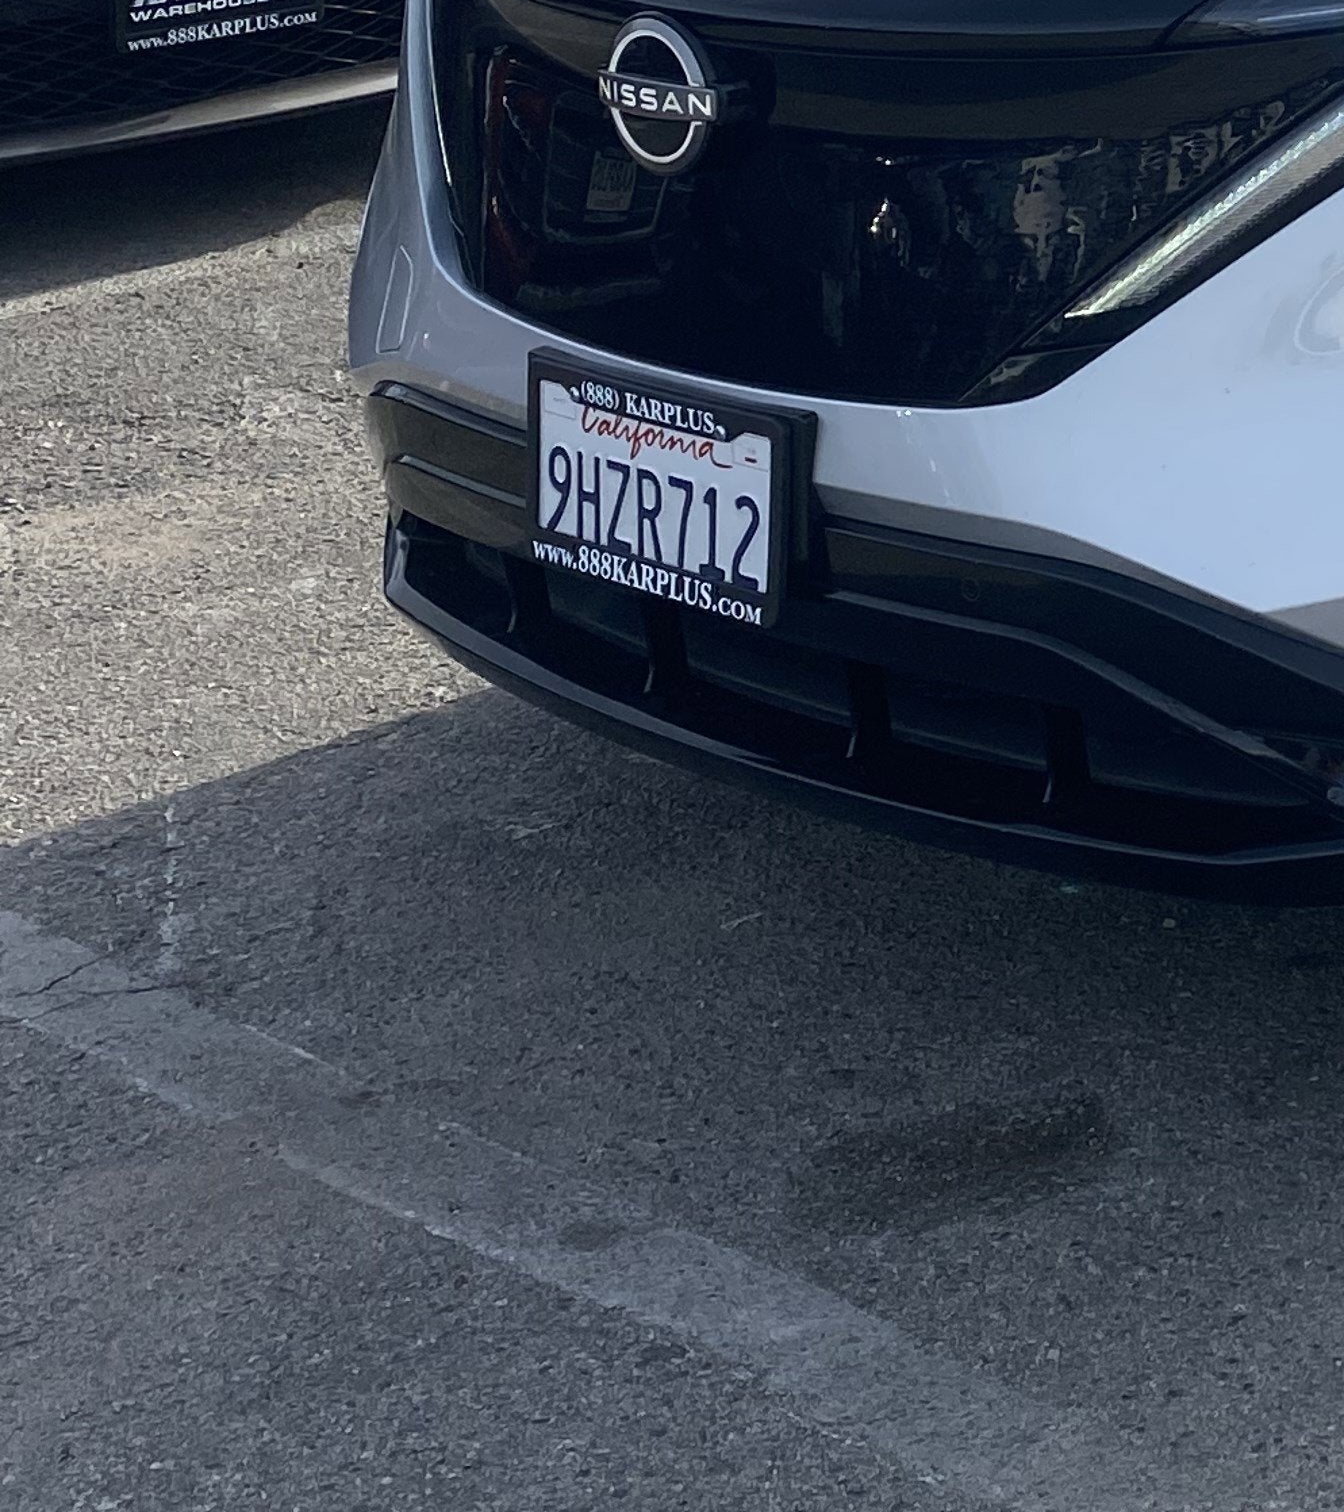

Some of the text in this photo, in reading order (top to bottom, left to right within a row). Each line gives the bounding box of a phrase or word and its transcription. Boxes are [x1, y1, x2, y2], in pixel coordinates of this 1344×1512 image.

[599, 75, 713, 116] NISSAN
[580, 380, 715, 435] (888) KARPLUS
[581, 405, 734, 469] California
[547, 444, 760, 593] 9HZR712
